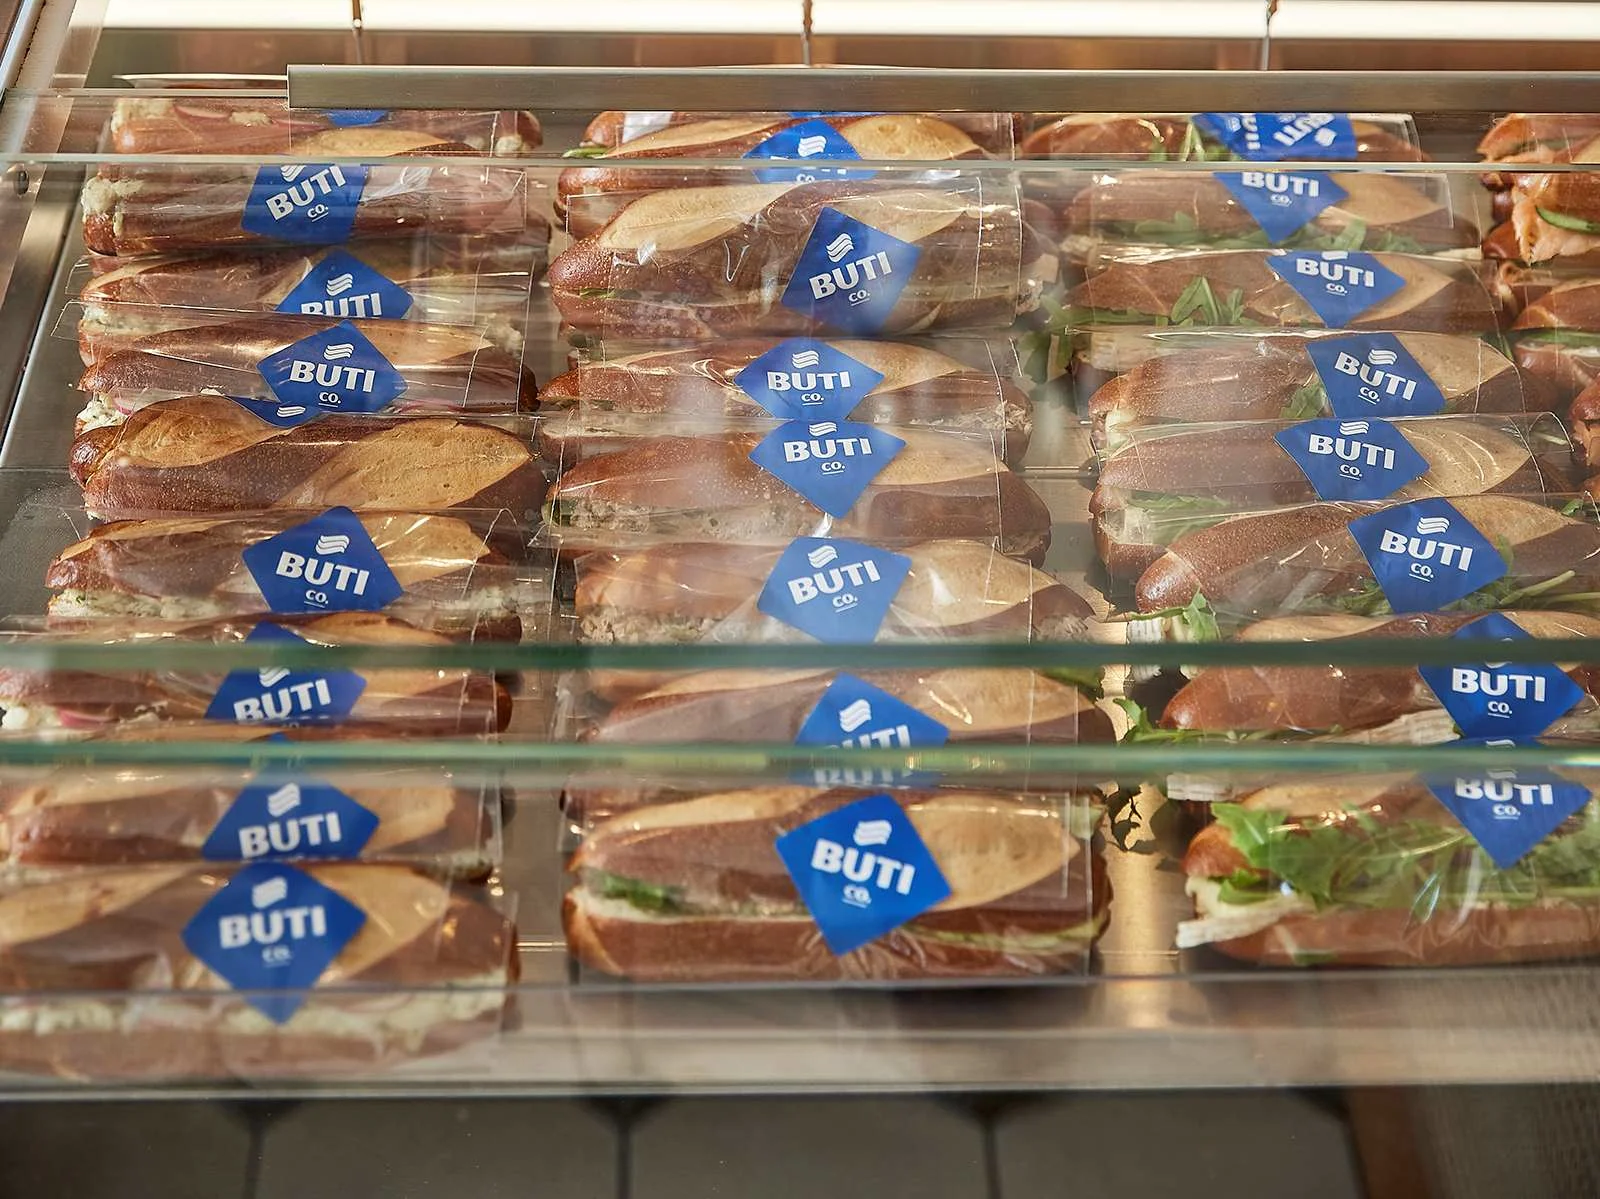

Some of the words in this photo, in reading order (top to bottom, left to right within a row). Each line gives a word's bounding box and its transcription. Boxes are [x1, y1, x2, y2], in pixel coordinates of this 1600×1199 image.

[265, 165, 346, 220] BUTI
[1242, 172, 1320, 197] BUTI
[307, 203, 329, 219] CO.
[808, 251, 893, 300] BUTI
[1296, 257, 1376, 288] BUTI
[848, 289, 871, 303] CO.
[1326, 282, 1348, 295] CO.
[289, 360, 376, 393] BUTI
[767, 371, 852, 391] BUTI
[1334, 352, 1417, 401] BUTI
[319, 391, 342, 404] CO.
[801, 392, 824, 402] CO.
[1358, 385, 1382, 404] CO.
[784, 438, 872, 462] BUTI
[1308, 434, 1396, 471] BUTI
[821, 461, 846, 472] CO.
[1340, 464, 1363, 477] CO.
[1379, 530, 1474, 572] BUTI
[275, 551, 370, 596] BUTI
[787, 560, 881, 605] BUTI
[1410, 563, 1435, 579] CO.
[305, 588, 329, 604] CO.
[832, 593, 859, 608] CO.
[1451, 667, 1546, 702] BUTI
[233, 679, 331, 721] BUTI
[1487, 701, 1513, 714] CO.
[1455, 777, 1554, 805] BUTI
[1492, 803, 1521, 816] CO.
[238, 812, 342, 858] BUTI
[811, 839, 916, 896] BUTI
[218, 906, 327, 949] BUTI
